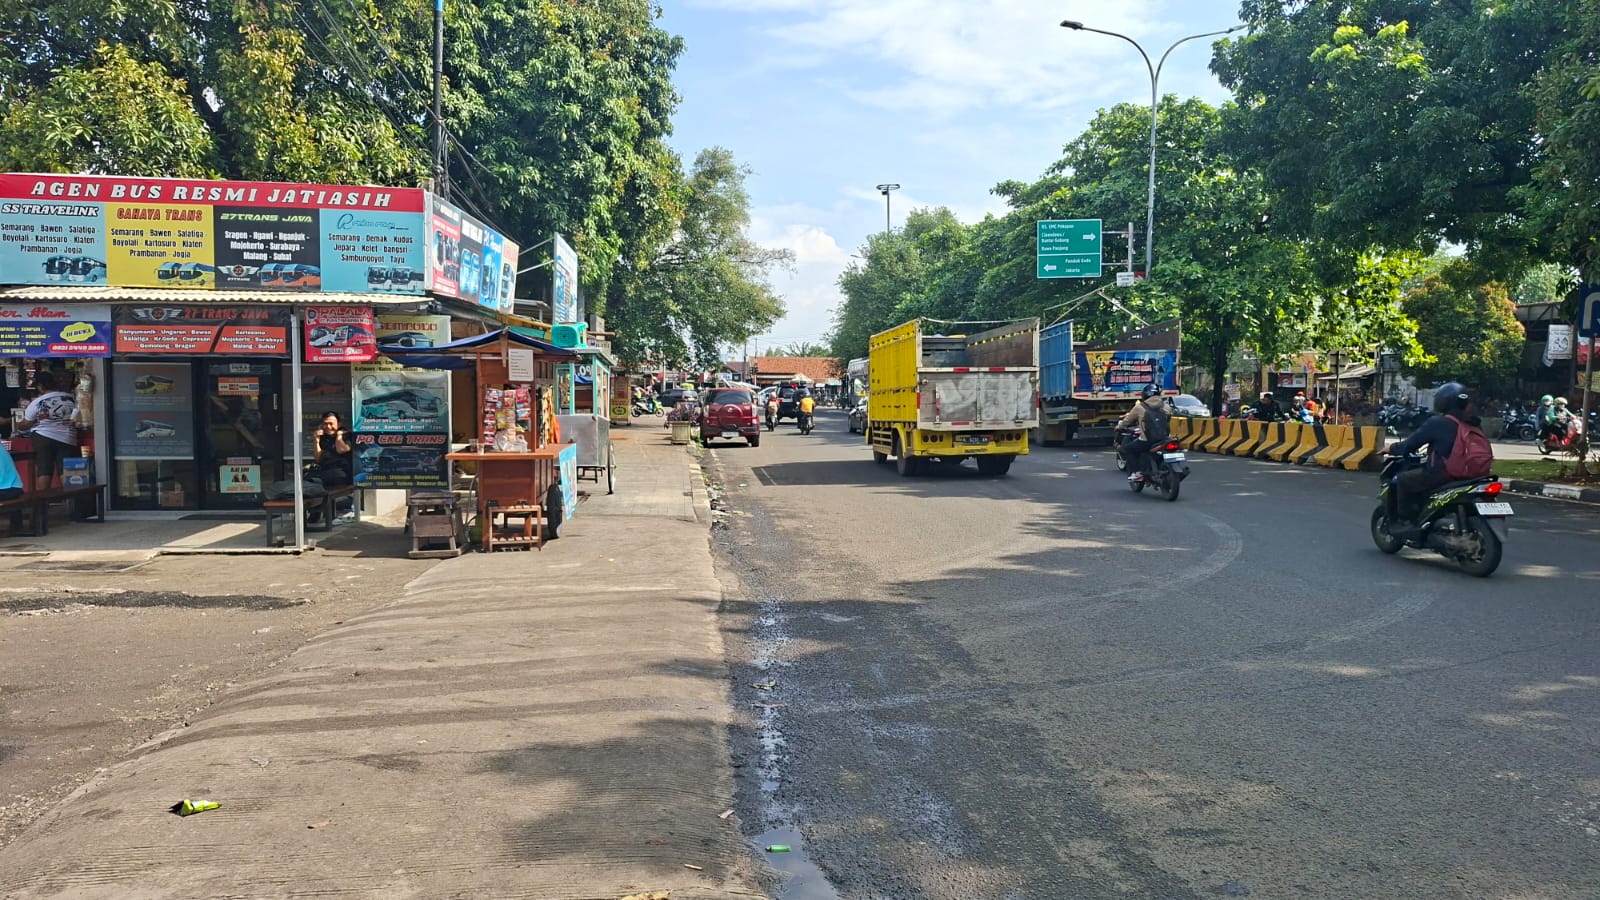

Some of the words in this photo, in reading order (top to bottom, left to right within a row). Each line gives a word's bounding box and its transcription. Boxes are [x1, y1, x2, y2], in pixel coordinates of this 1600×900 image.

[30, 181, 101, 198] AGEN
[110, 184, 163, 199] BUS
[173, 186, 258, 202] RESMI
[268, 188, 392, 207] JATIASIH
[2, 204, 20, 215] SS
[22, 204, 99, 217] TRAVELINK
[116, 208, 162, 221] CAHAYA
[165, 209, 203, 222] TRANS
[220, 213, 279, 222] 27TRANS
[282, 215, 313, 223] JAVA
[1, 223, 35, 234] Semarang
[40, 224, 63, 233] Bawen
[69, 224, 96, 235] Salatiga
[111, 228, 144, 239] Semarang
[150, 229, 172, 238] Bawen
[177, 229, 204, 240] Salatiga
[2, 234, 30, 244] Boyolali
[74, 235, 95, 244] Klaten
[225, 231, 248, 241] Sragen
[328, 233, 361, 243] Semarang
[366, 234, 388, 242] Demak
[394, 235, 413, 243] Kudus
[112, 238, 139, 248] Boyolali
[182, 240, 203, 248] Klaten
[269, 242, 301, 252] Surabaya
[20, 245, 57, 254] Prambanan
[63, 245, 83, 255] Jogja
[129, 249, 166, 258] Prambanan
[172, 250, 191, 259] Jogja
[243, 252, 268, 262] Malang
[202, 308, 237, 319] TRANS
[242, 309, 269, 319] JAVA
